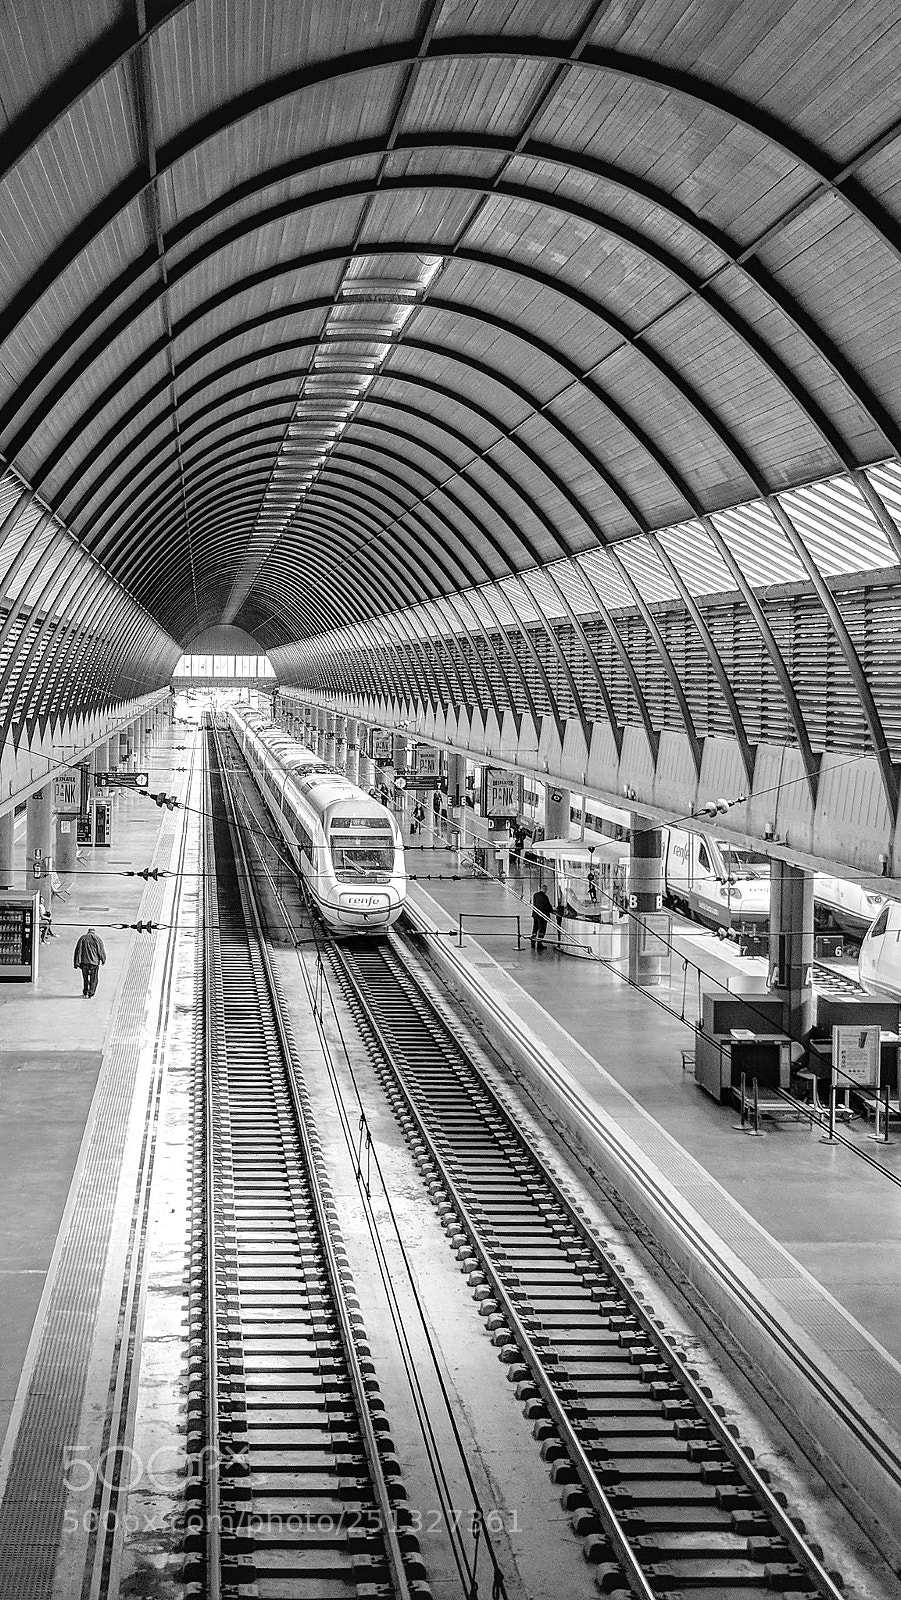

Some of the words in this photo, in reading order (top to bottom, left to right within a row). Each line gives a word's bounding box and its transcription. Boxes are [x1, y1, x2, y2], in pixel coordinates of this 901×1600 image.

[448, 796, 453, 806] E
[461, 797, 466, 806] E
[493, 787, 514, 806] PINK
[488, 820, 494, 829] D
[348, 896, 380, 907] renfe
[629, 894, 638, 909] B
[741, 945, 748, 955] 7
[834, 946, 842, 957] 6
